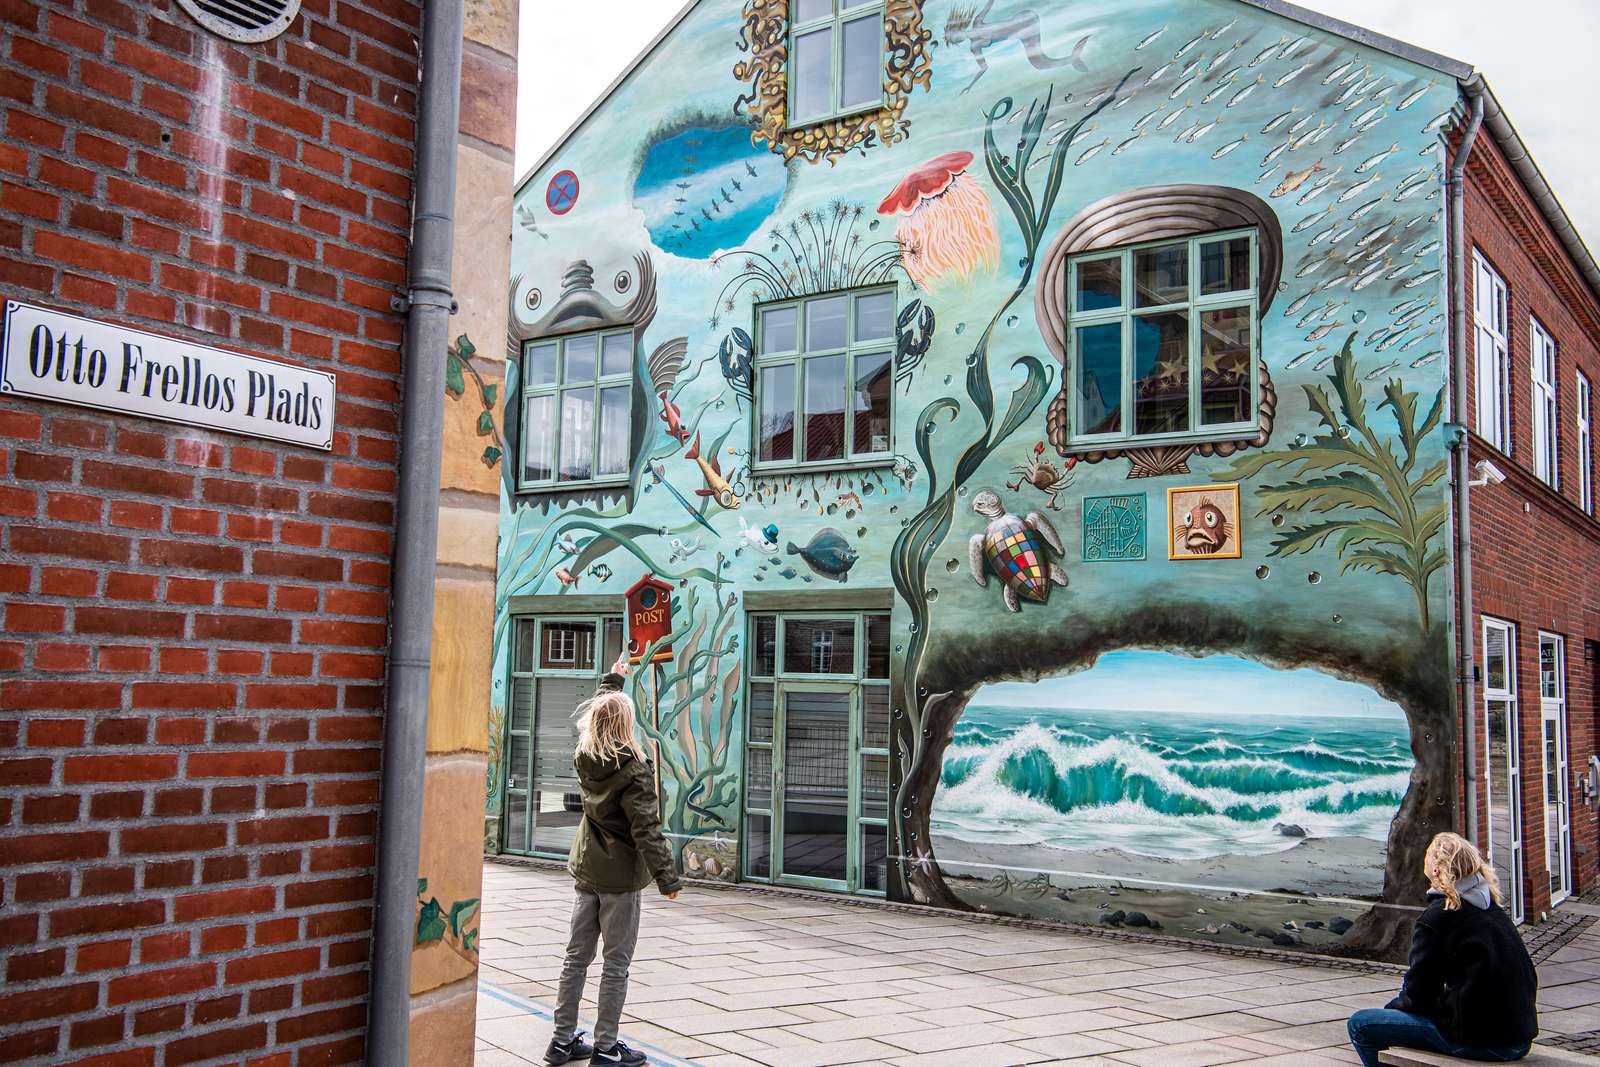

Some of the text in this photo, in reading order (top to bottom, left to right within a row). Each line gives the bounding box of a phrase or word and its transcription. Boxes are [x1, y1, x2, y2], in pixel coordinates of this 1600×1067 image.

[29, 324, 322, 430] Otto Frellos Plads
[635, 609, 665, 626] POST
